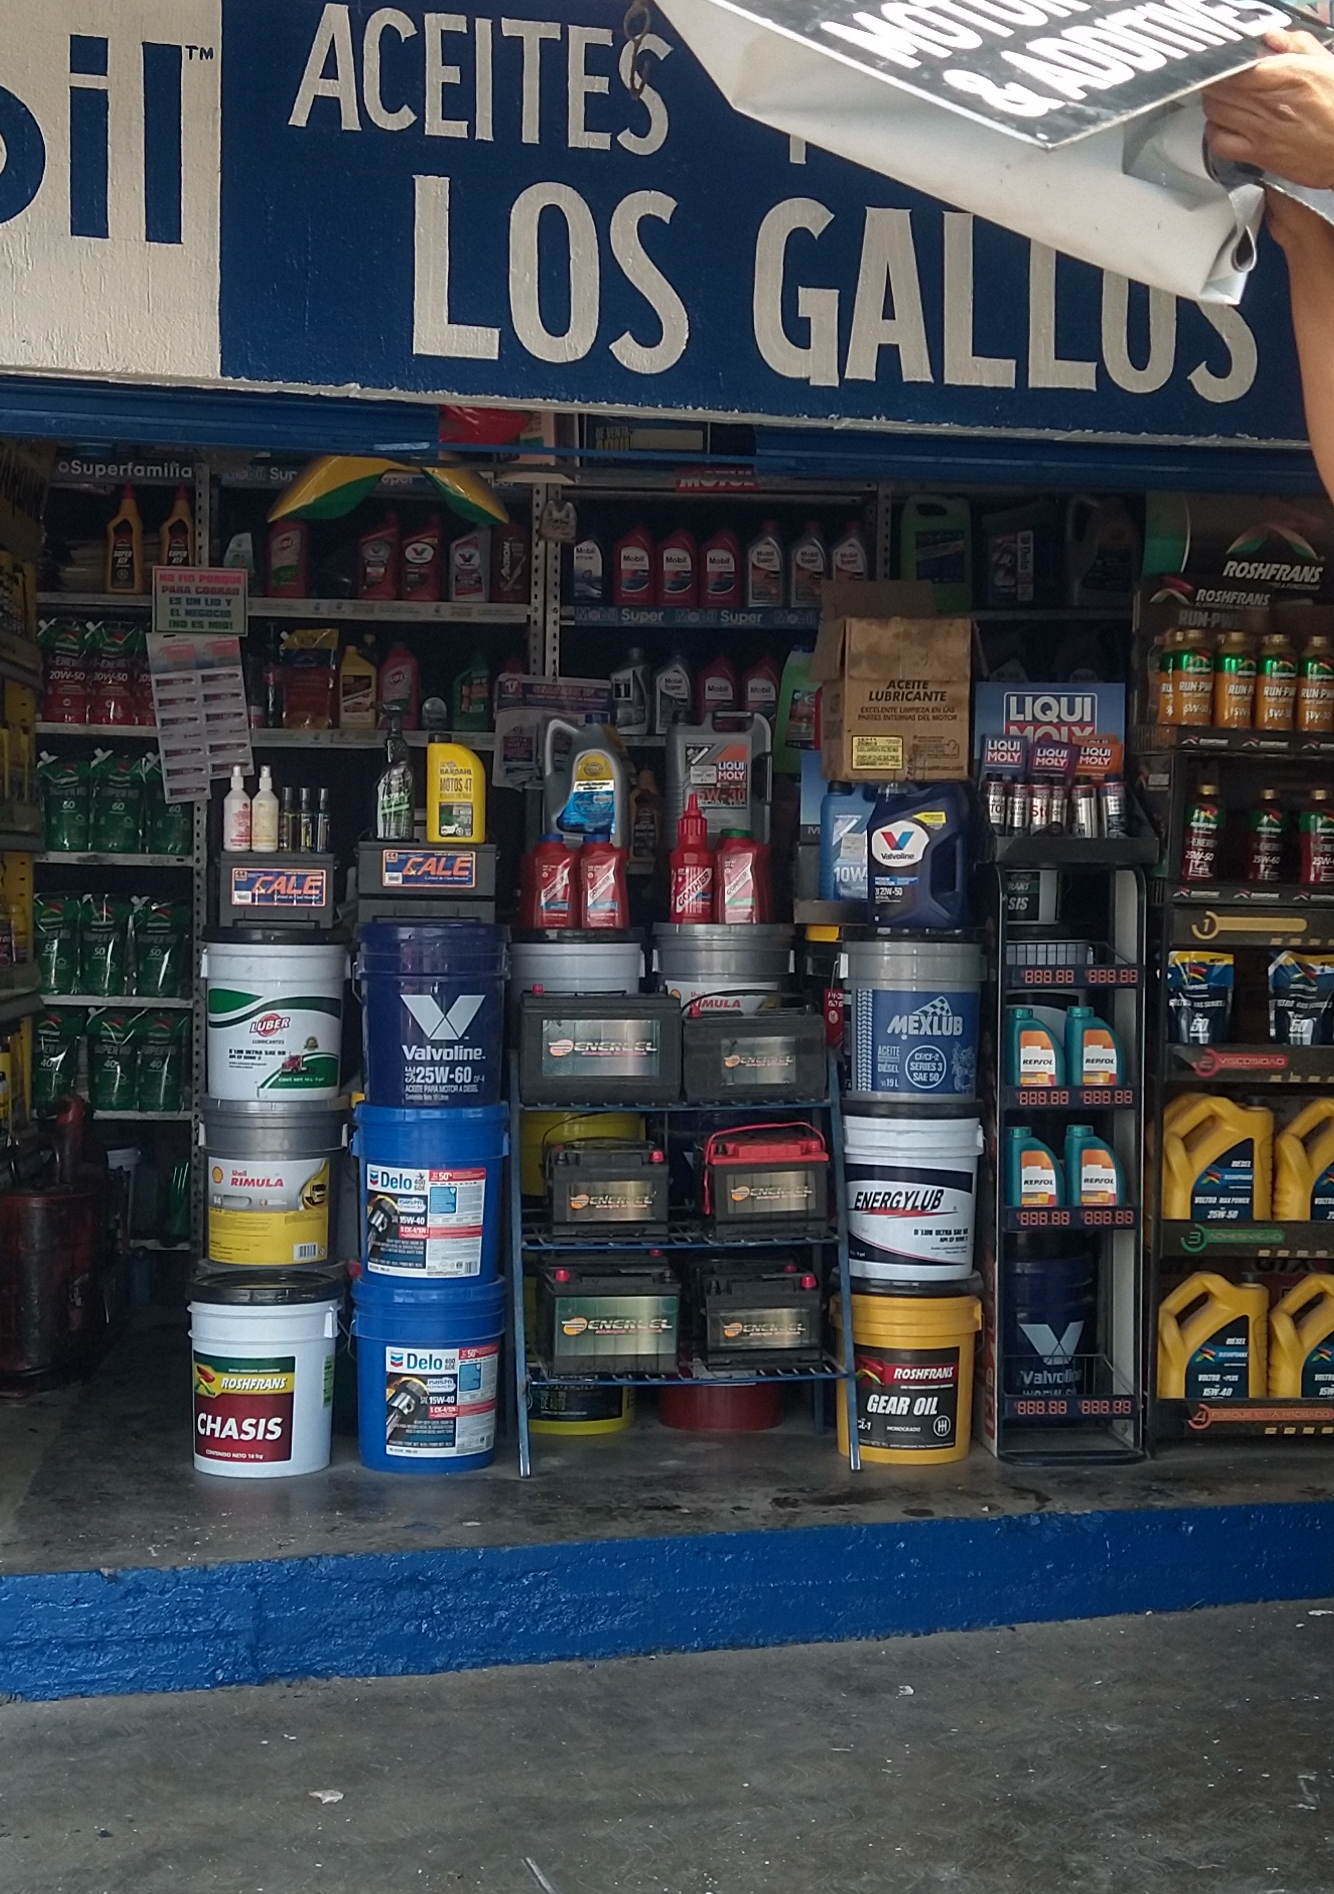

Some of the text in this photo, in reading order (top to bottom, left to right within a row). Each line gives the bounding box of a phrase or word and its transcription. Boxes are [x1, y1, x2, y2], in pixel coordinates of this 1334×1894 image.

[288, 2, 671, 157] ACEITES
[943, 69, 1065, 118] &
[411, 174, 690, 376] LOS
[71, 460, 193, 480] Superfamilia
[623, 554, 645, 563] Mobil
[666, 556, 687, 565] Mobil
[709, 557, 730, 565] Mobil
[1222, 560, 1323, 583] ROSHFRANS
[160, 574, 241, 584] NO PORQUE
[162, 586, 240, 595] PARA COBRAR
[169, 597, 182, 605] ES
[186, 597, 200, 605] UN
[1195, 588, 1270, 605] ROSHFRANS
[170, 608, 231, 617] EL NEGOCIO
[577, 609, 816, 624] Mobil Super Mobil Super Mobil
[49, 671, 85, 681] 20W-50
[708, 684, 728, 693] Mobil
[750, 685, 770, 693] Mobil
[887, 680, 929, 689] ACEITE
[868, 691, 947, 702] LUBRICANTE
[1010, 696, 1092, 722] LIQUI
[987, 739, 1020, 751] LIQUI
[1037, 748, 1068, 758] LIQUI
[1080, 747, 1112, 757] LIQUI
[987, 752, 1021, 763] MOLY
[1036, 757, 1068, 767] MOLY
[1079, 755, 1111, 765] MOLY
[718, 761, 745, 771] LIQUI
[718, 771, 745, 780] MOLY
[440, 778, 462, 792] MOTOS
[402, 857, 472, 876] CALE
[251, 876, 323, 894] CALE
[249, 1016, 291, 1033] LUBER
[887, 1015, 963, 1038] MEXLUB
[402, 1045, 484, 1061] Valvoline
[878, 1045, 900, 1056] ACEITE
[910, 1062, 936, 1071] SERIES
[1022, 1058, 1053, 1067] REPSOL
[1085, 1057, 1114, 1066] REPSOL
[1219, 1057, 1285, 1066] VISCOSIDAD
[416, 1066, 472, 1084] 25W-60
[913, 1072, 939, 1081] SAE 50
[405, 1084, 458, 1093] ACEITE MOTOR
[230, 1177, 284, 1188] RIMULA
[381, 1172, 412, 1190] Delo
[1023, 1178, 1053, 1186] REPSOL
[1083, 1177, 1114, 1185] REPSOL
[854, 1189, 944, 1211] ENERGYLUB
[1194, 1197, 1217, 1205] VOLTRO
[400, 1216, 425, 1225] 15W-40
[407, 1353, 443, 1370] Delo
[894, 1367, 953, 1380] ROSHFRANS
[1198, 1374, 1221, 1382] VOLTRO
[221, 1377, 287, 1392] ROSHFRANS
[1202, 1387, 1233, 1398] 15W-40
[429, 1395, 455, 1405] 15W-40
[867, 1395, 938, 1416] GEAR OIL
[197, 1413, 283, 1441] CHASIS
